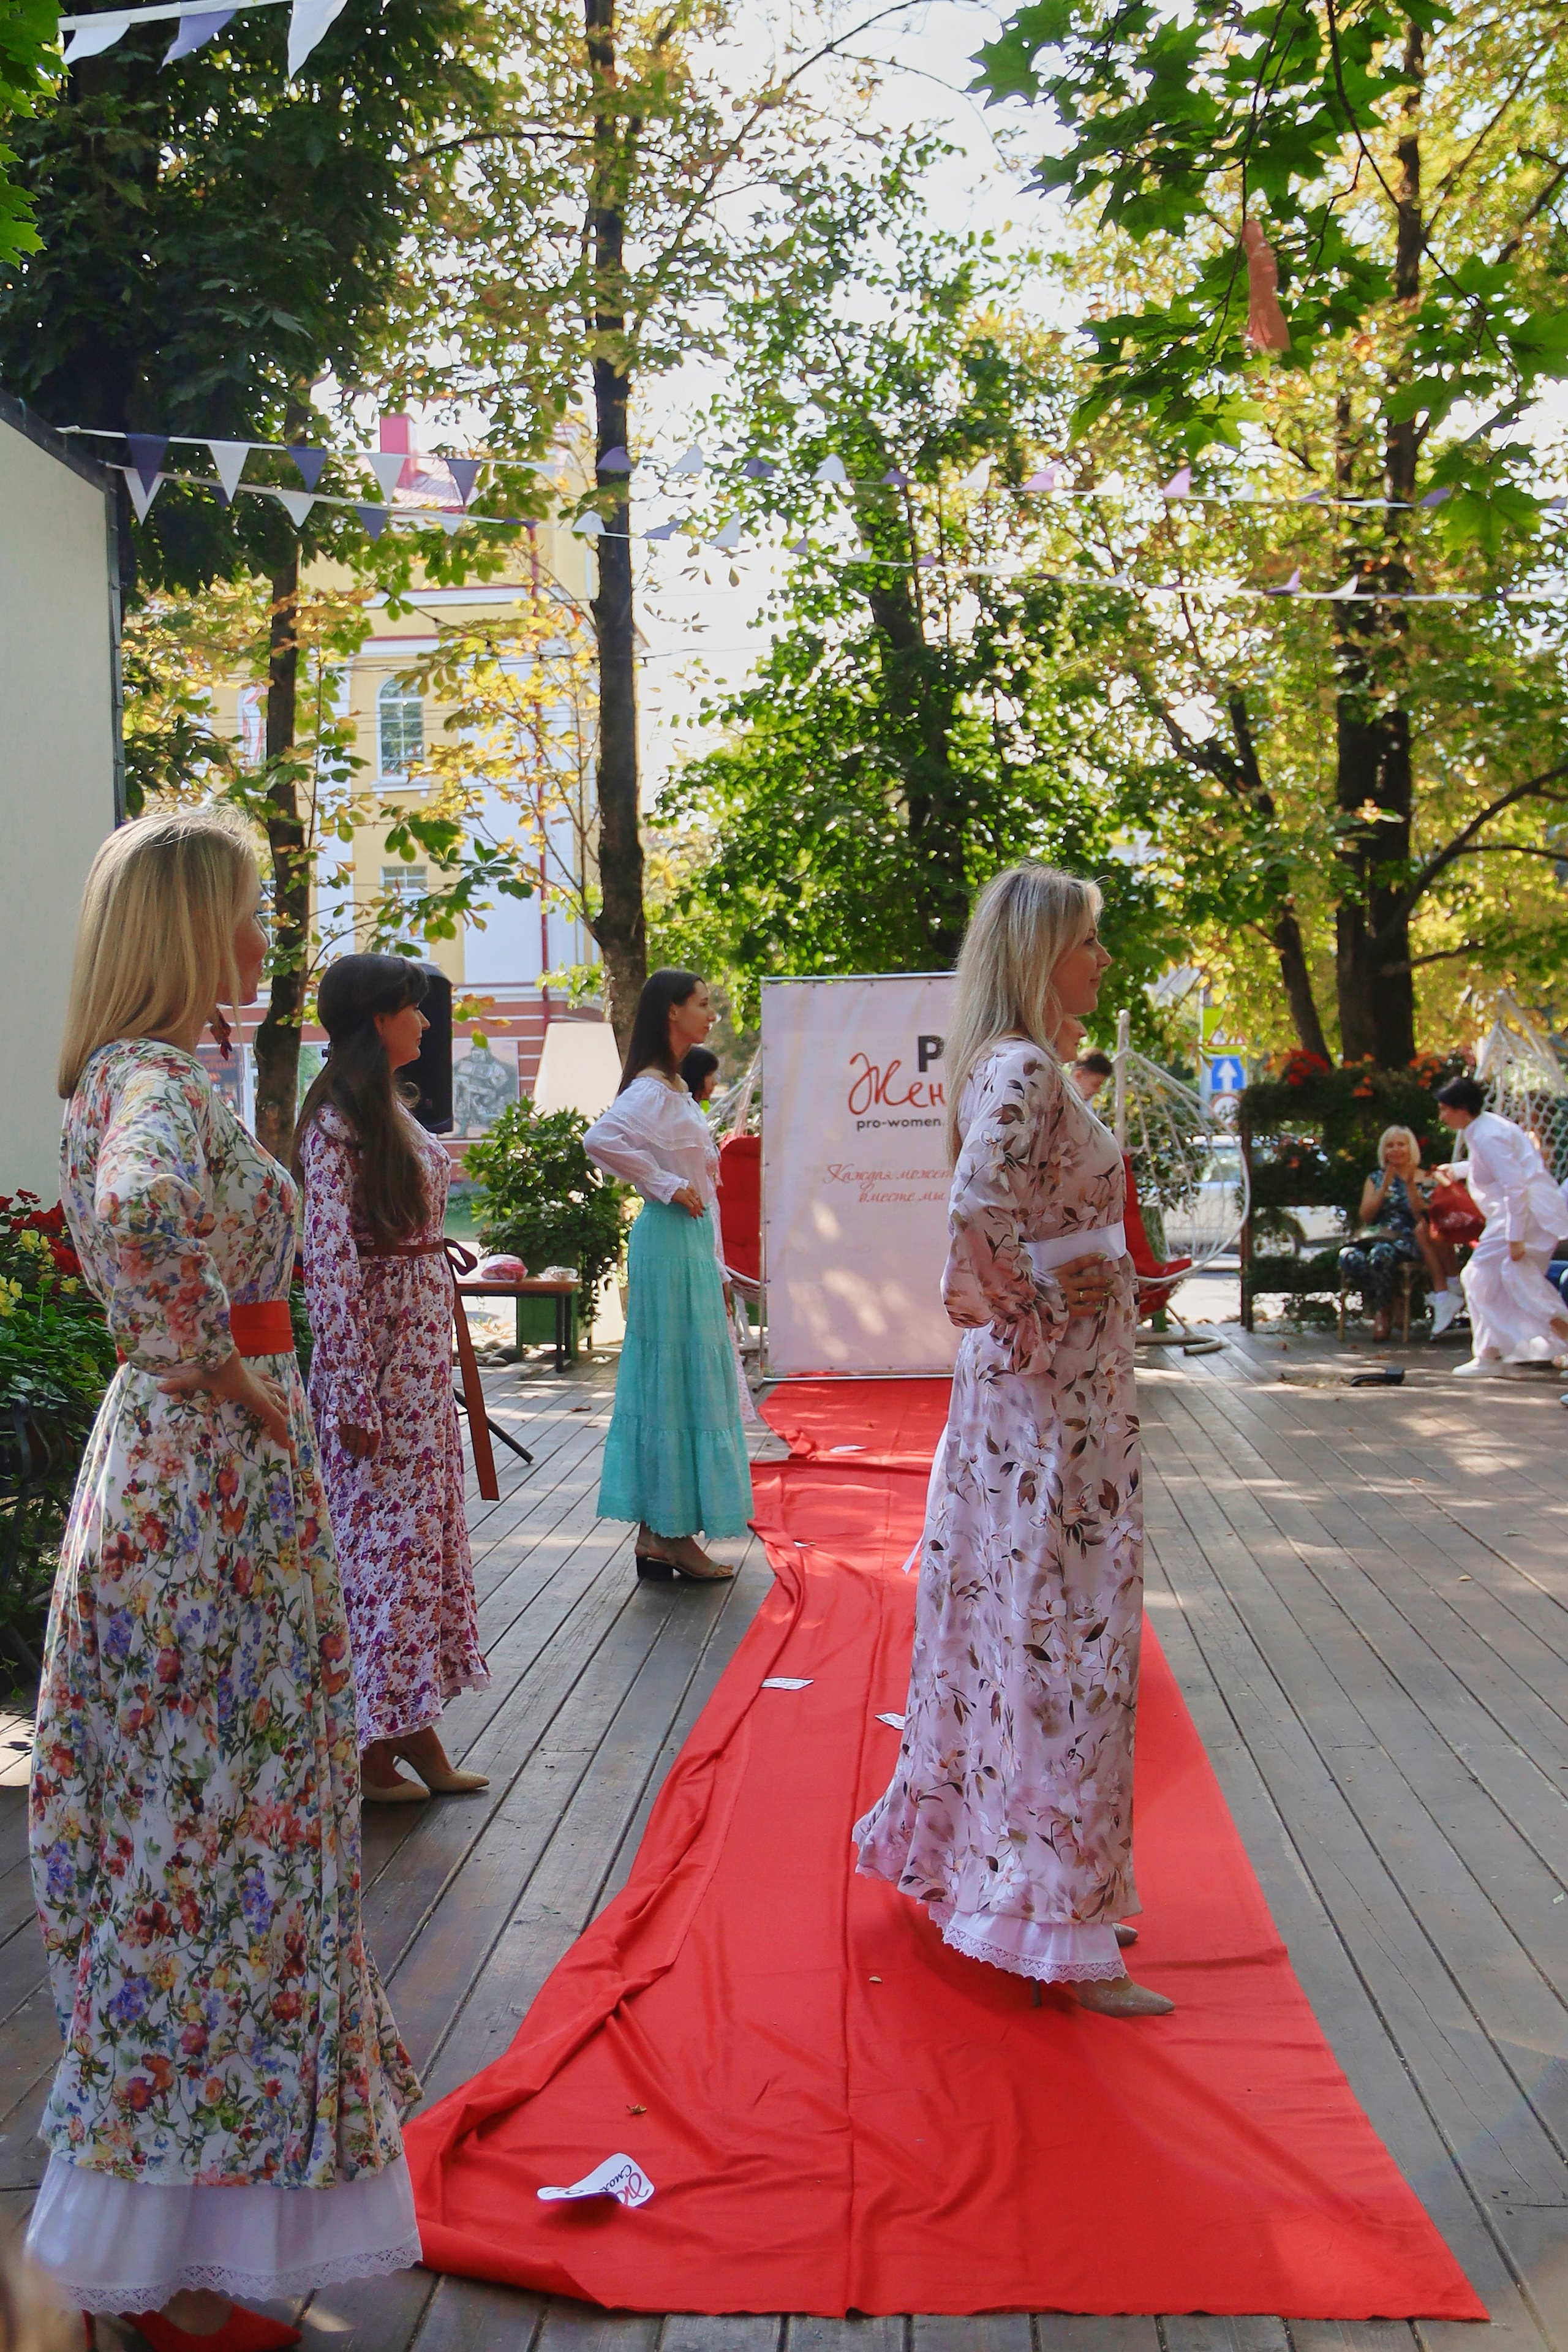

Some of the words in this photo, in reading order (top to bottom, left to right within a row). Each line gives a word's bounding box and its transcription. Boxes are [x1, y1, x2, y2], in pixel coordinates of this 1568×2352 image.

[823, 1163, 892, 1190] Каждая
[859, 1186, 916, 1203] вместе
[918, 1191, 946, 1202] мы
